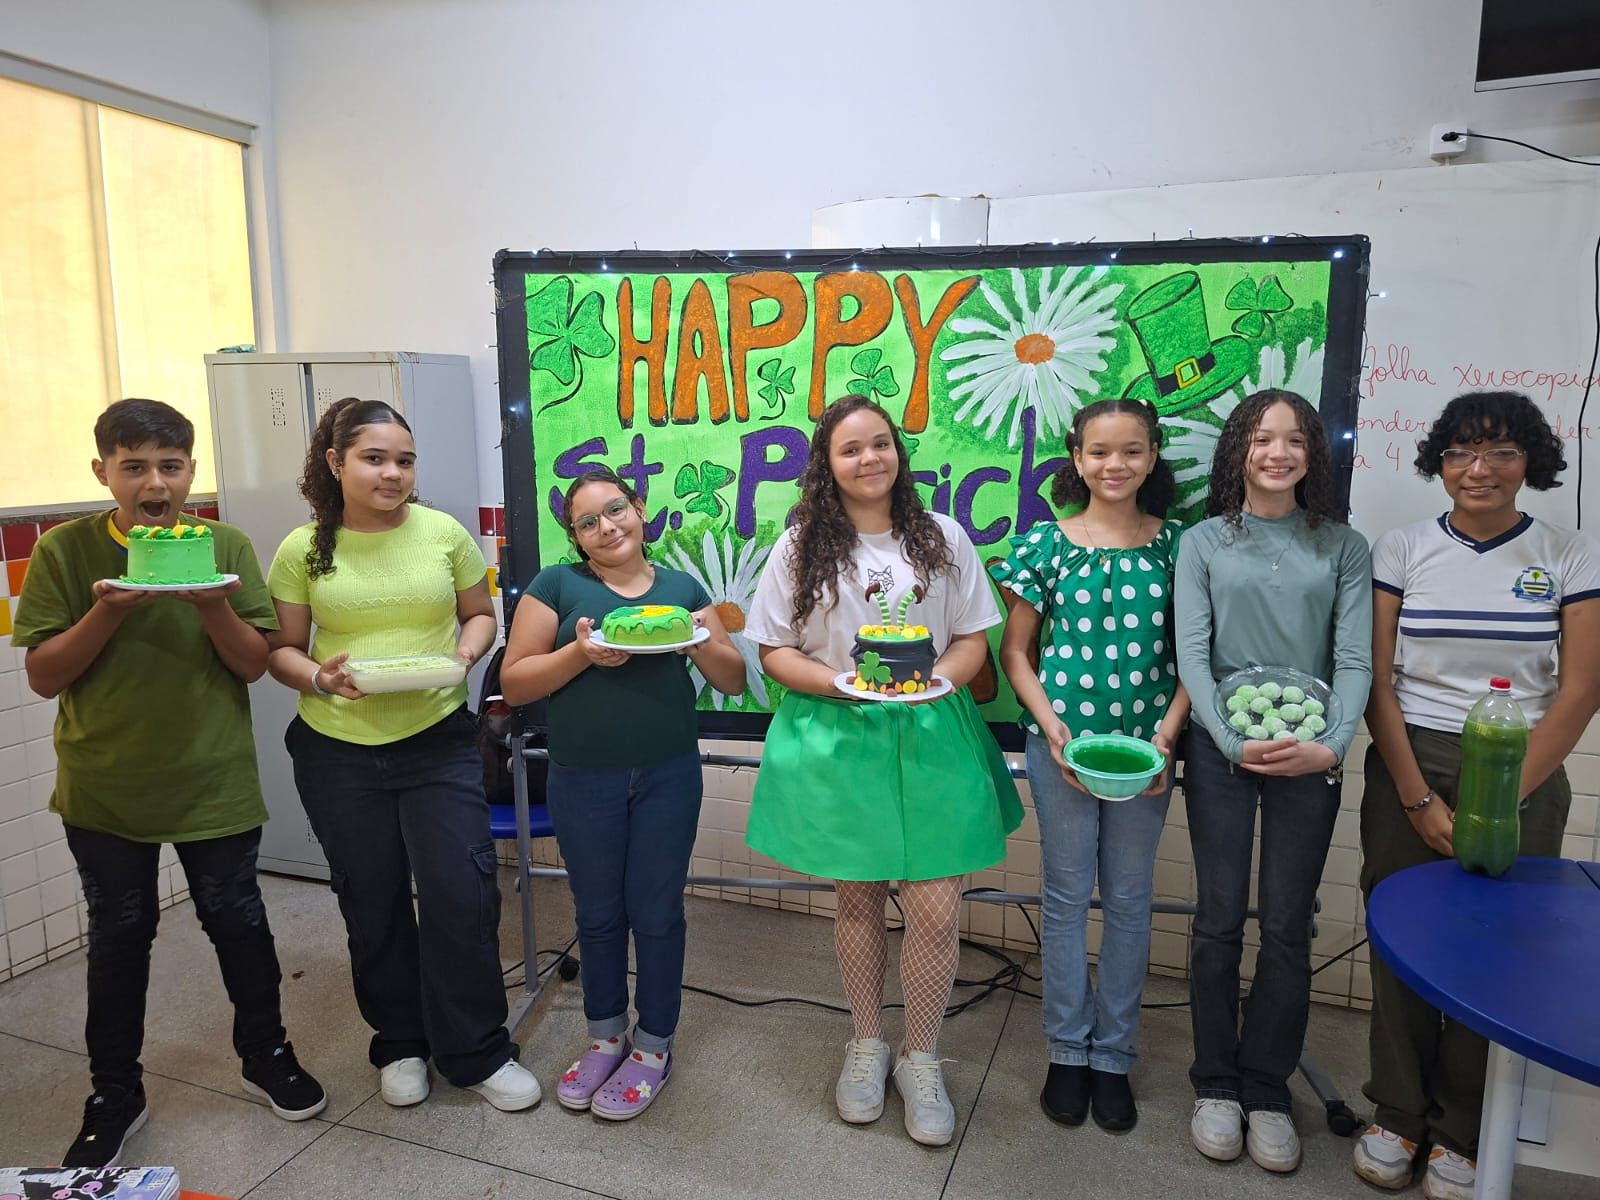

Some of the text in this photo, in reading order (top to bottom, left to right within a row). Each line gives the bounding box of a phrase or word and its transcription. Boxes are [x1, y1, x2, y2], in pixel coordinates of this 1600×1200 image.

[616, 271, 982, 434] HAPPY
[1364, 343, 1437, 397] folha
[1357, 409, 1430, 434] onder
[1385, 442, 1400, 472] 4
[548, 433, 683, 543] St.
